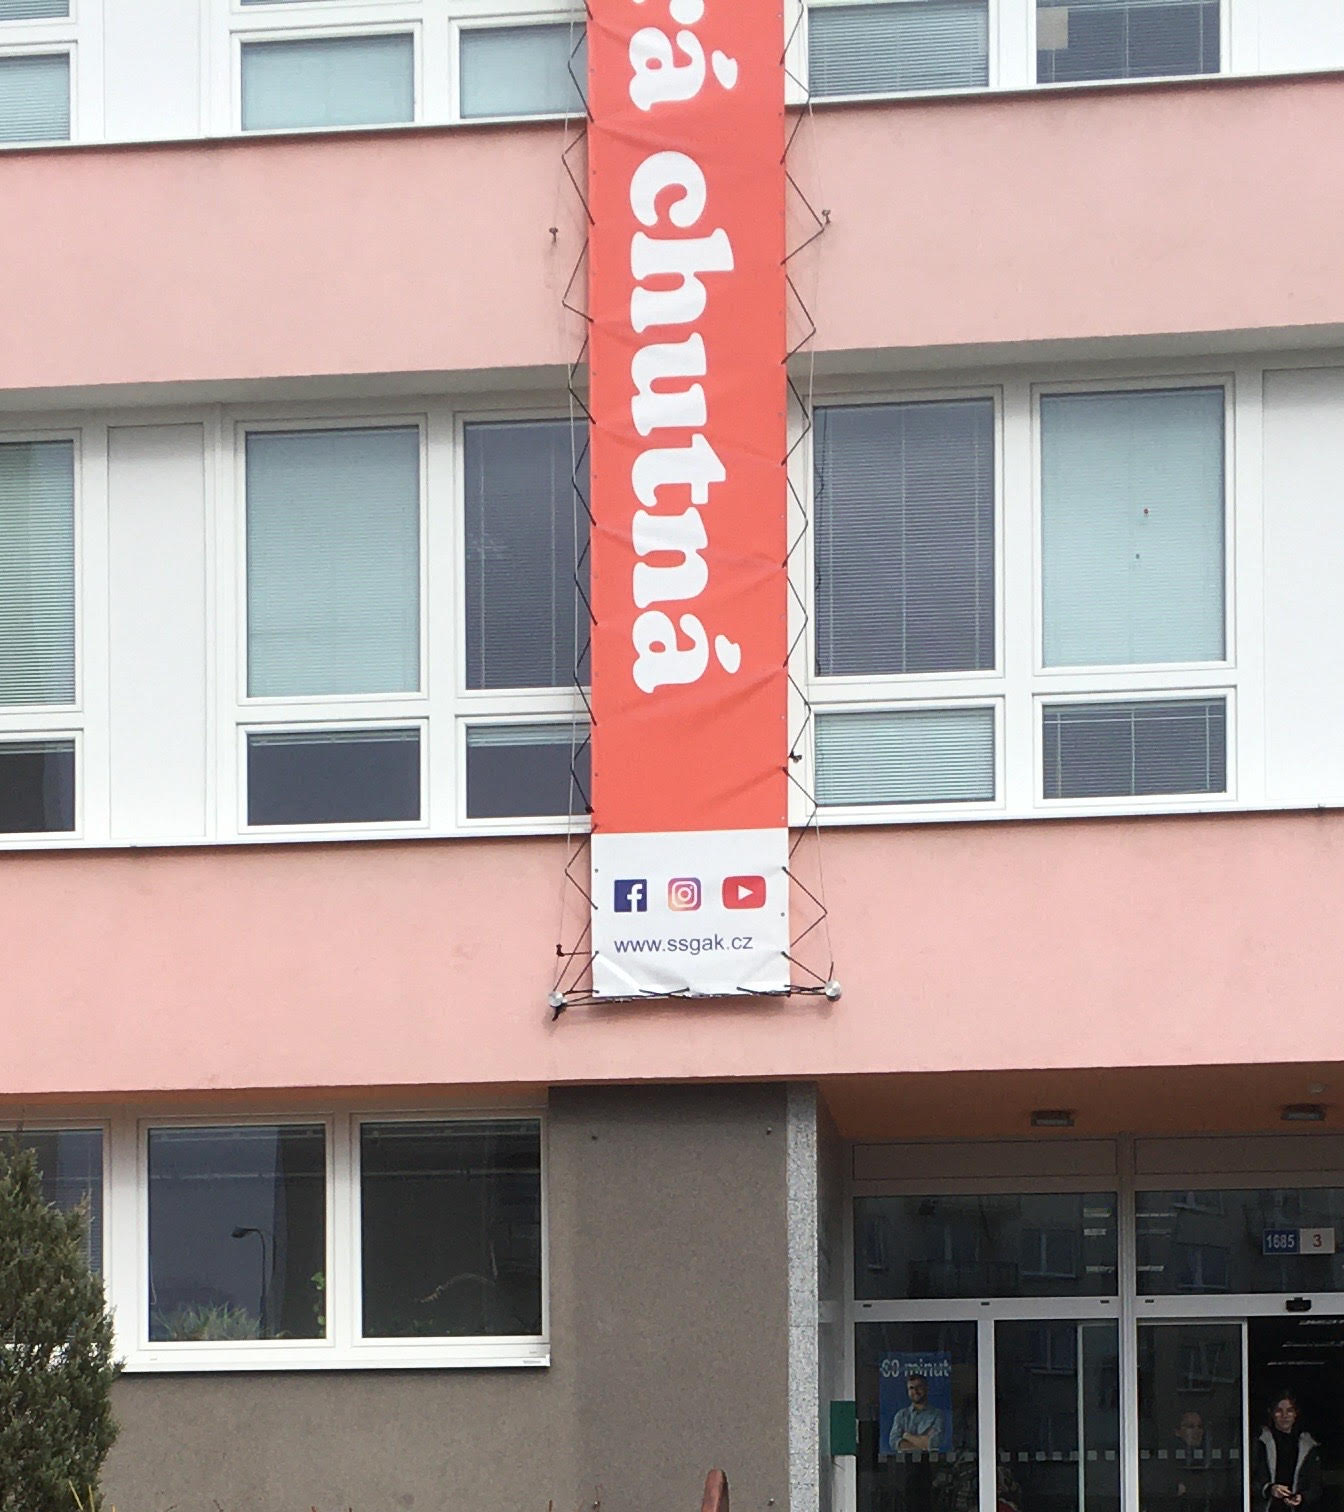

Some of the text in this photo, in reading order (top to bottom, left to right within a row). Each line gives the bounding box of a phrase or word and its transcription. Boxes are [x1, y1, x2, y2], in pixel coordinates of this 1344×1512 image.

[629, 150, 742, 694] chutná
[613, 934, 754, 956] www.ssgak.cz
[1266, 1234, 1295, 1249] 1685
[1312, 1234, 1323, 1248] 3
